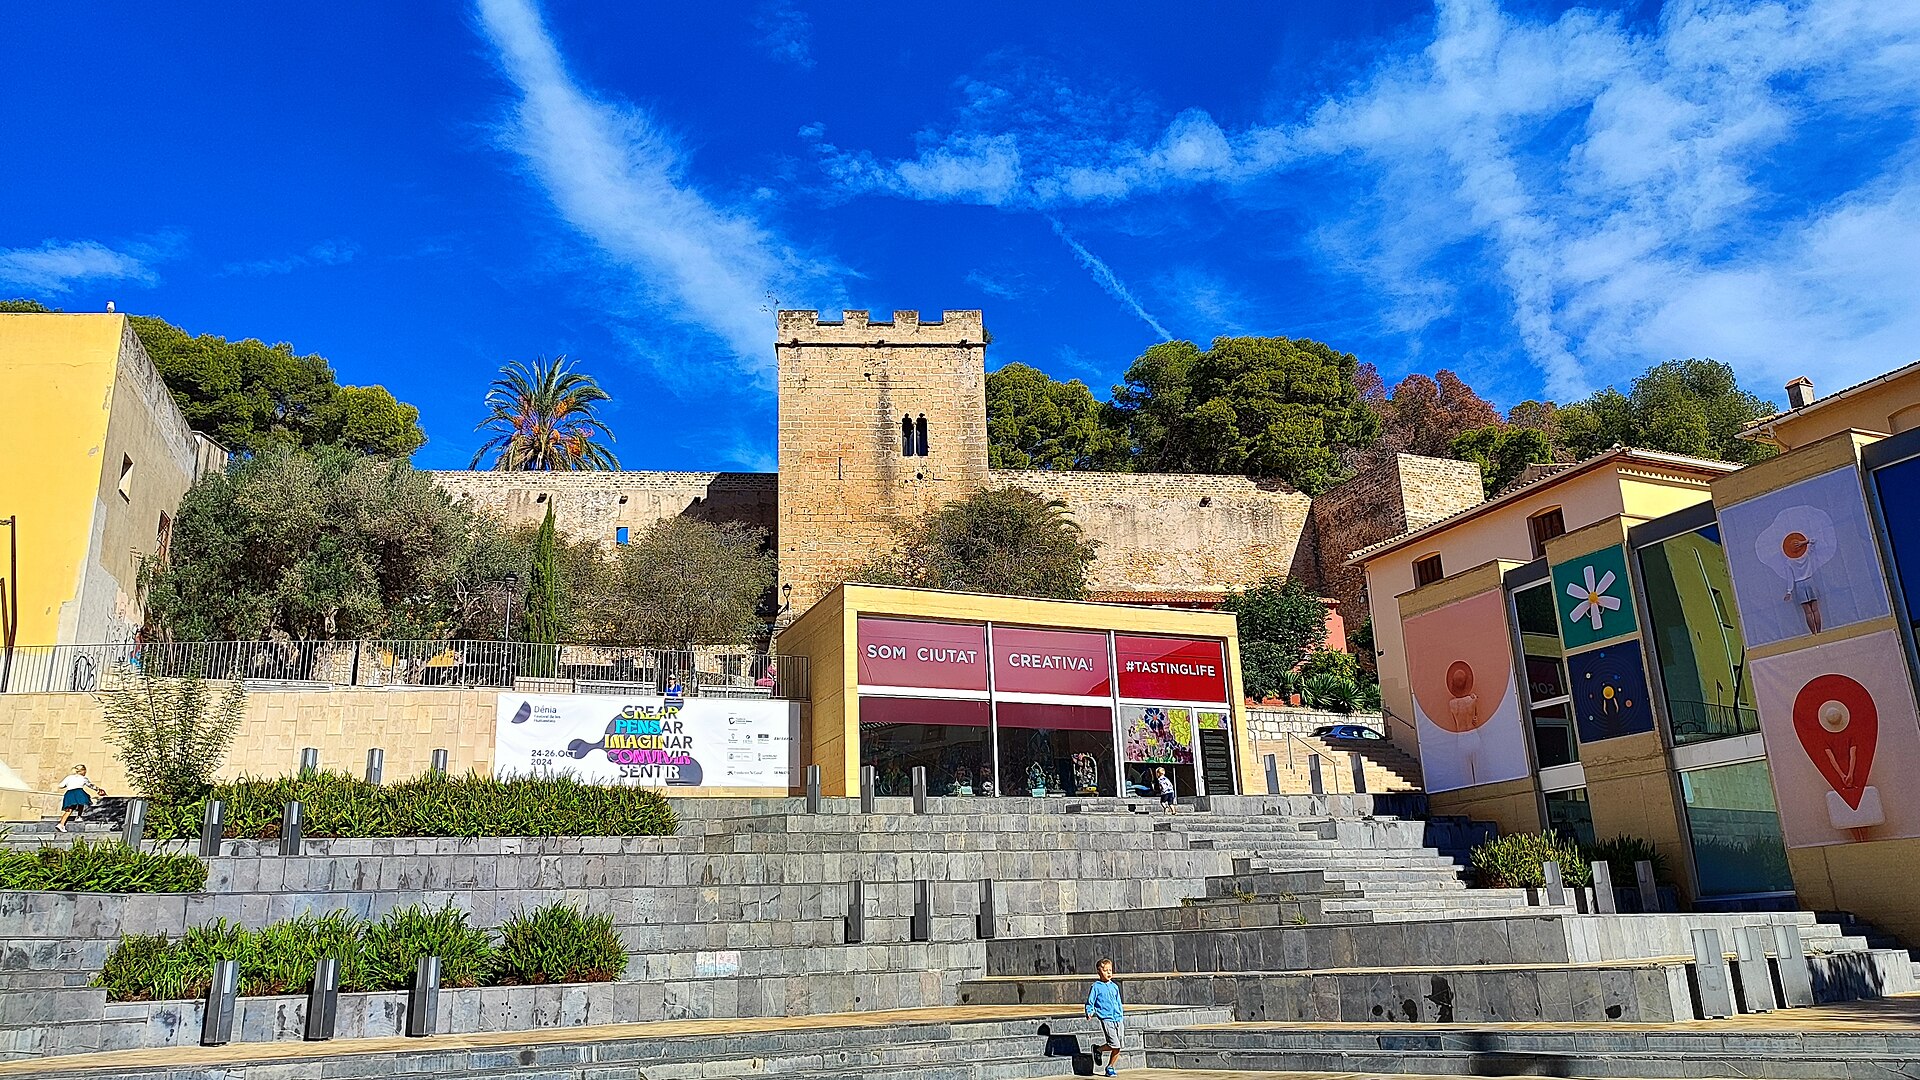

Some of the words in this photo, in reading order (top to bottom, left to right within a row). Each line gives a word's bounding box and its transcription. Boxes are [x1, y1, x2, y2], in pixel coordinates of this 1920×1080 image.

[867, 644, 906, 660] SOM
[917, 647, 978, 664] CIUTAT
[1008, 653, 1094, 671] CREATIVA!
[1125, 660, 1216, 677] #TASTINGLIFE
[533, 705, 557, 714] Dénia
[620, 704, 679, 720] CREAR
[615, 719, 684, 735] PENSAR
[604, 733, 693, 749] IMAGINAR
[531, 749, 578, 758] 24-26.OCT
[607, 748, 691, 765] CONVIVIR
[531, 758, 552, 766] 2024
[619, 764, 680, 779] SENTIR
